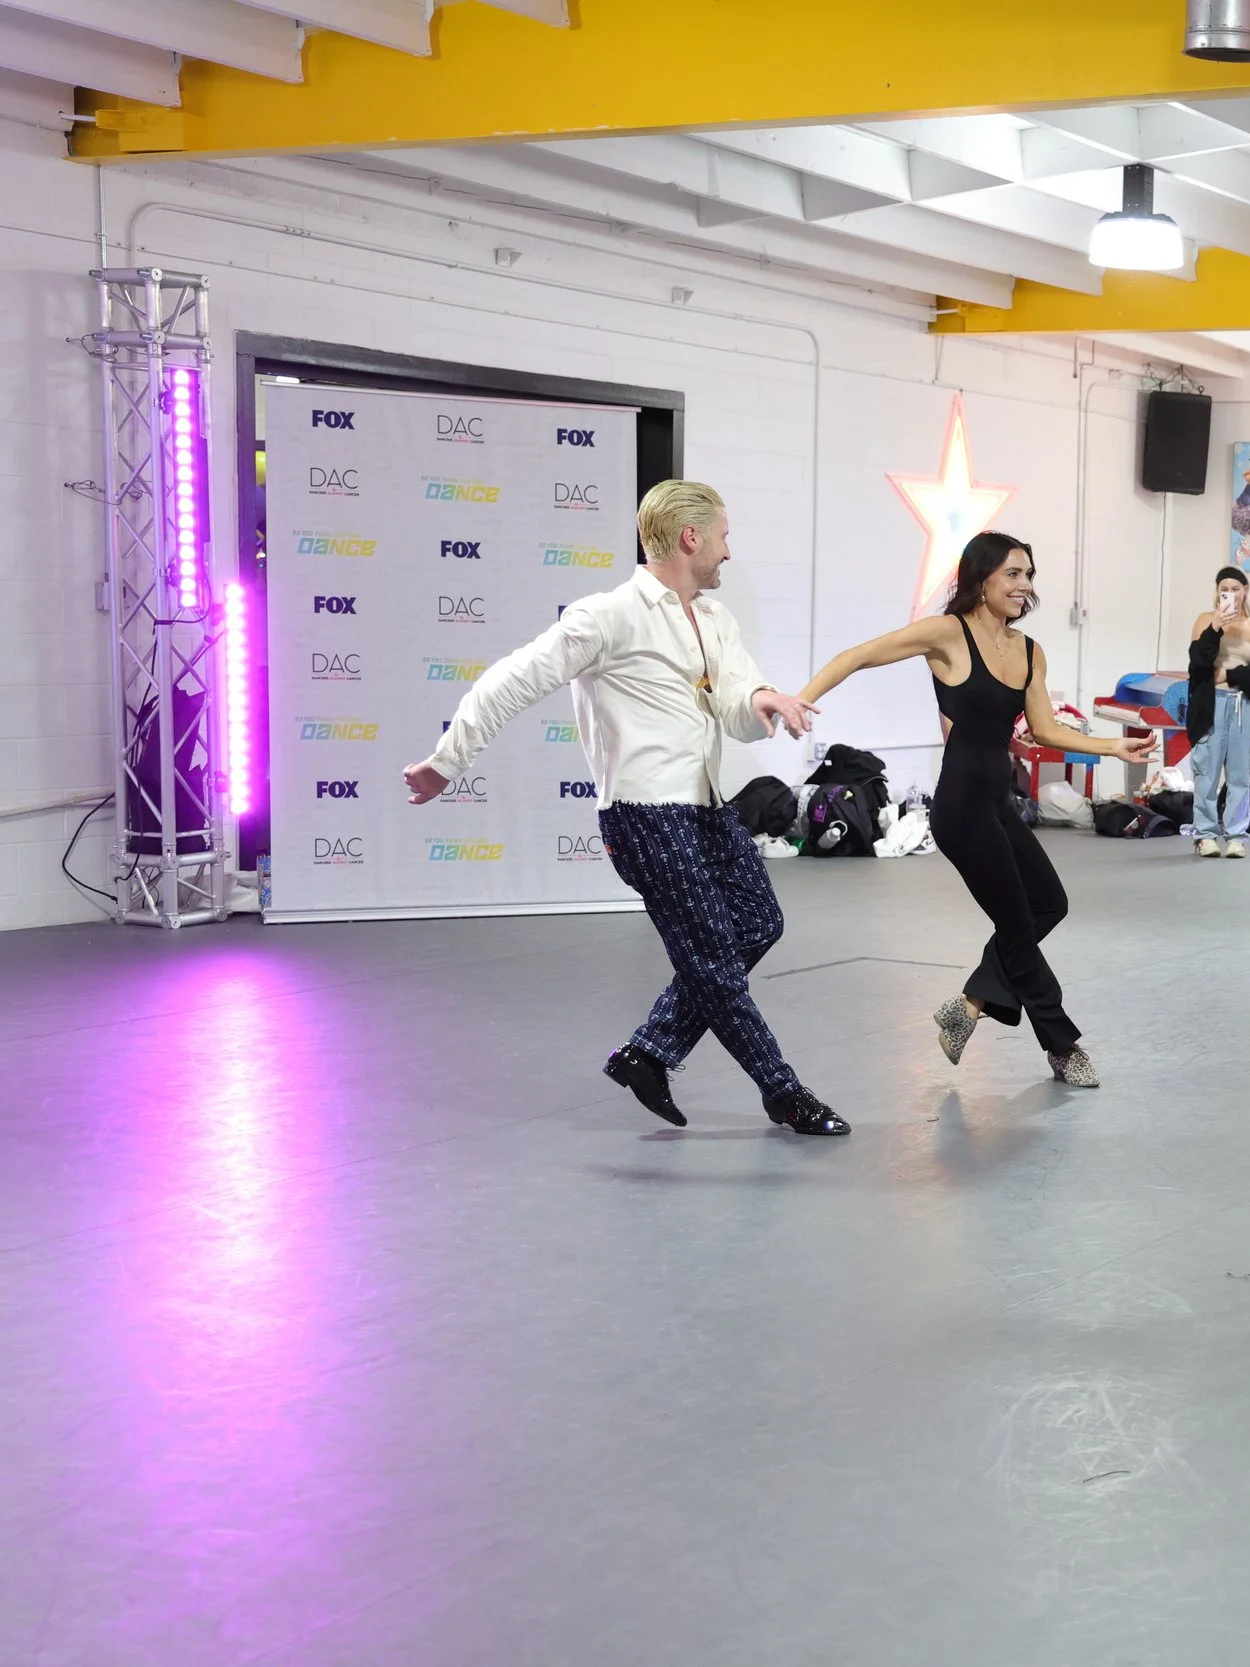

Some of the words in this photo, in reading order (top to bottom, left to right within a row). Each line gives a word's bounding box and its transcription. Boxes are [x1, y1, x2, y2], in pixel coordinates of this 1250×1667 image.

[312, 410, 355, 430] FOX
[437, 415, 483, 437] DAC
[557, 428, 595, 447] FOX
[310, 467, 359, 489] DAC
[555, 483, 598, 504] DAC
[441, 540, 481, 559] FOX
[314, 596, 357, 614] FOX
[439, 596, 484, 617] DAC
[312, 653, 360, 674] DAC
[317, 781, 359, 798] FOX
[560, 782, 598, 798] FOX
[315, 837, 363, 858] DAC
[558, 836, 601, 855] DAC
